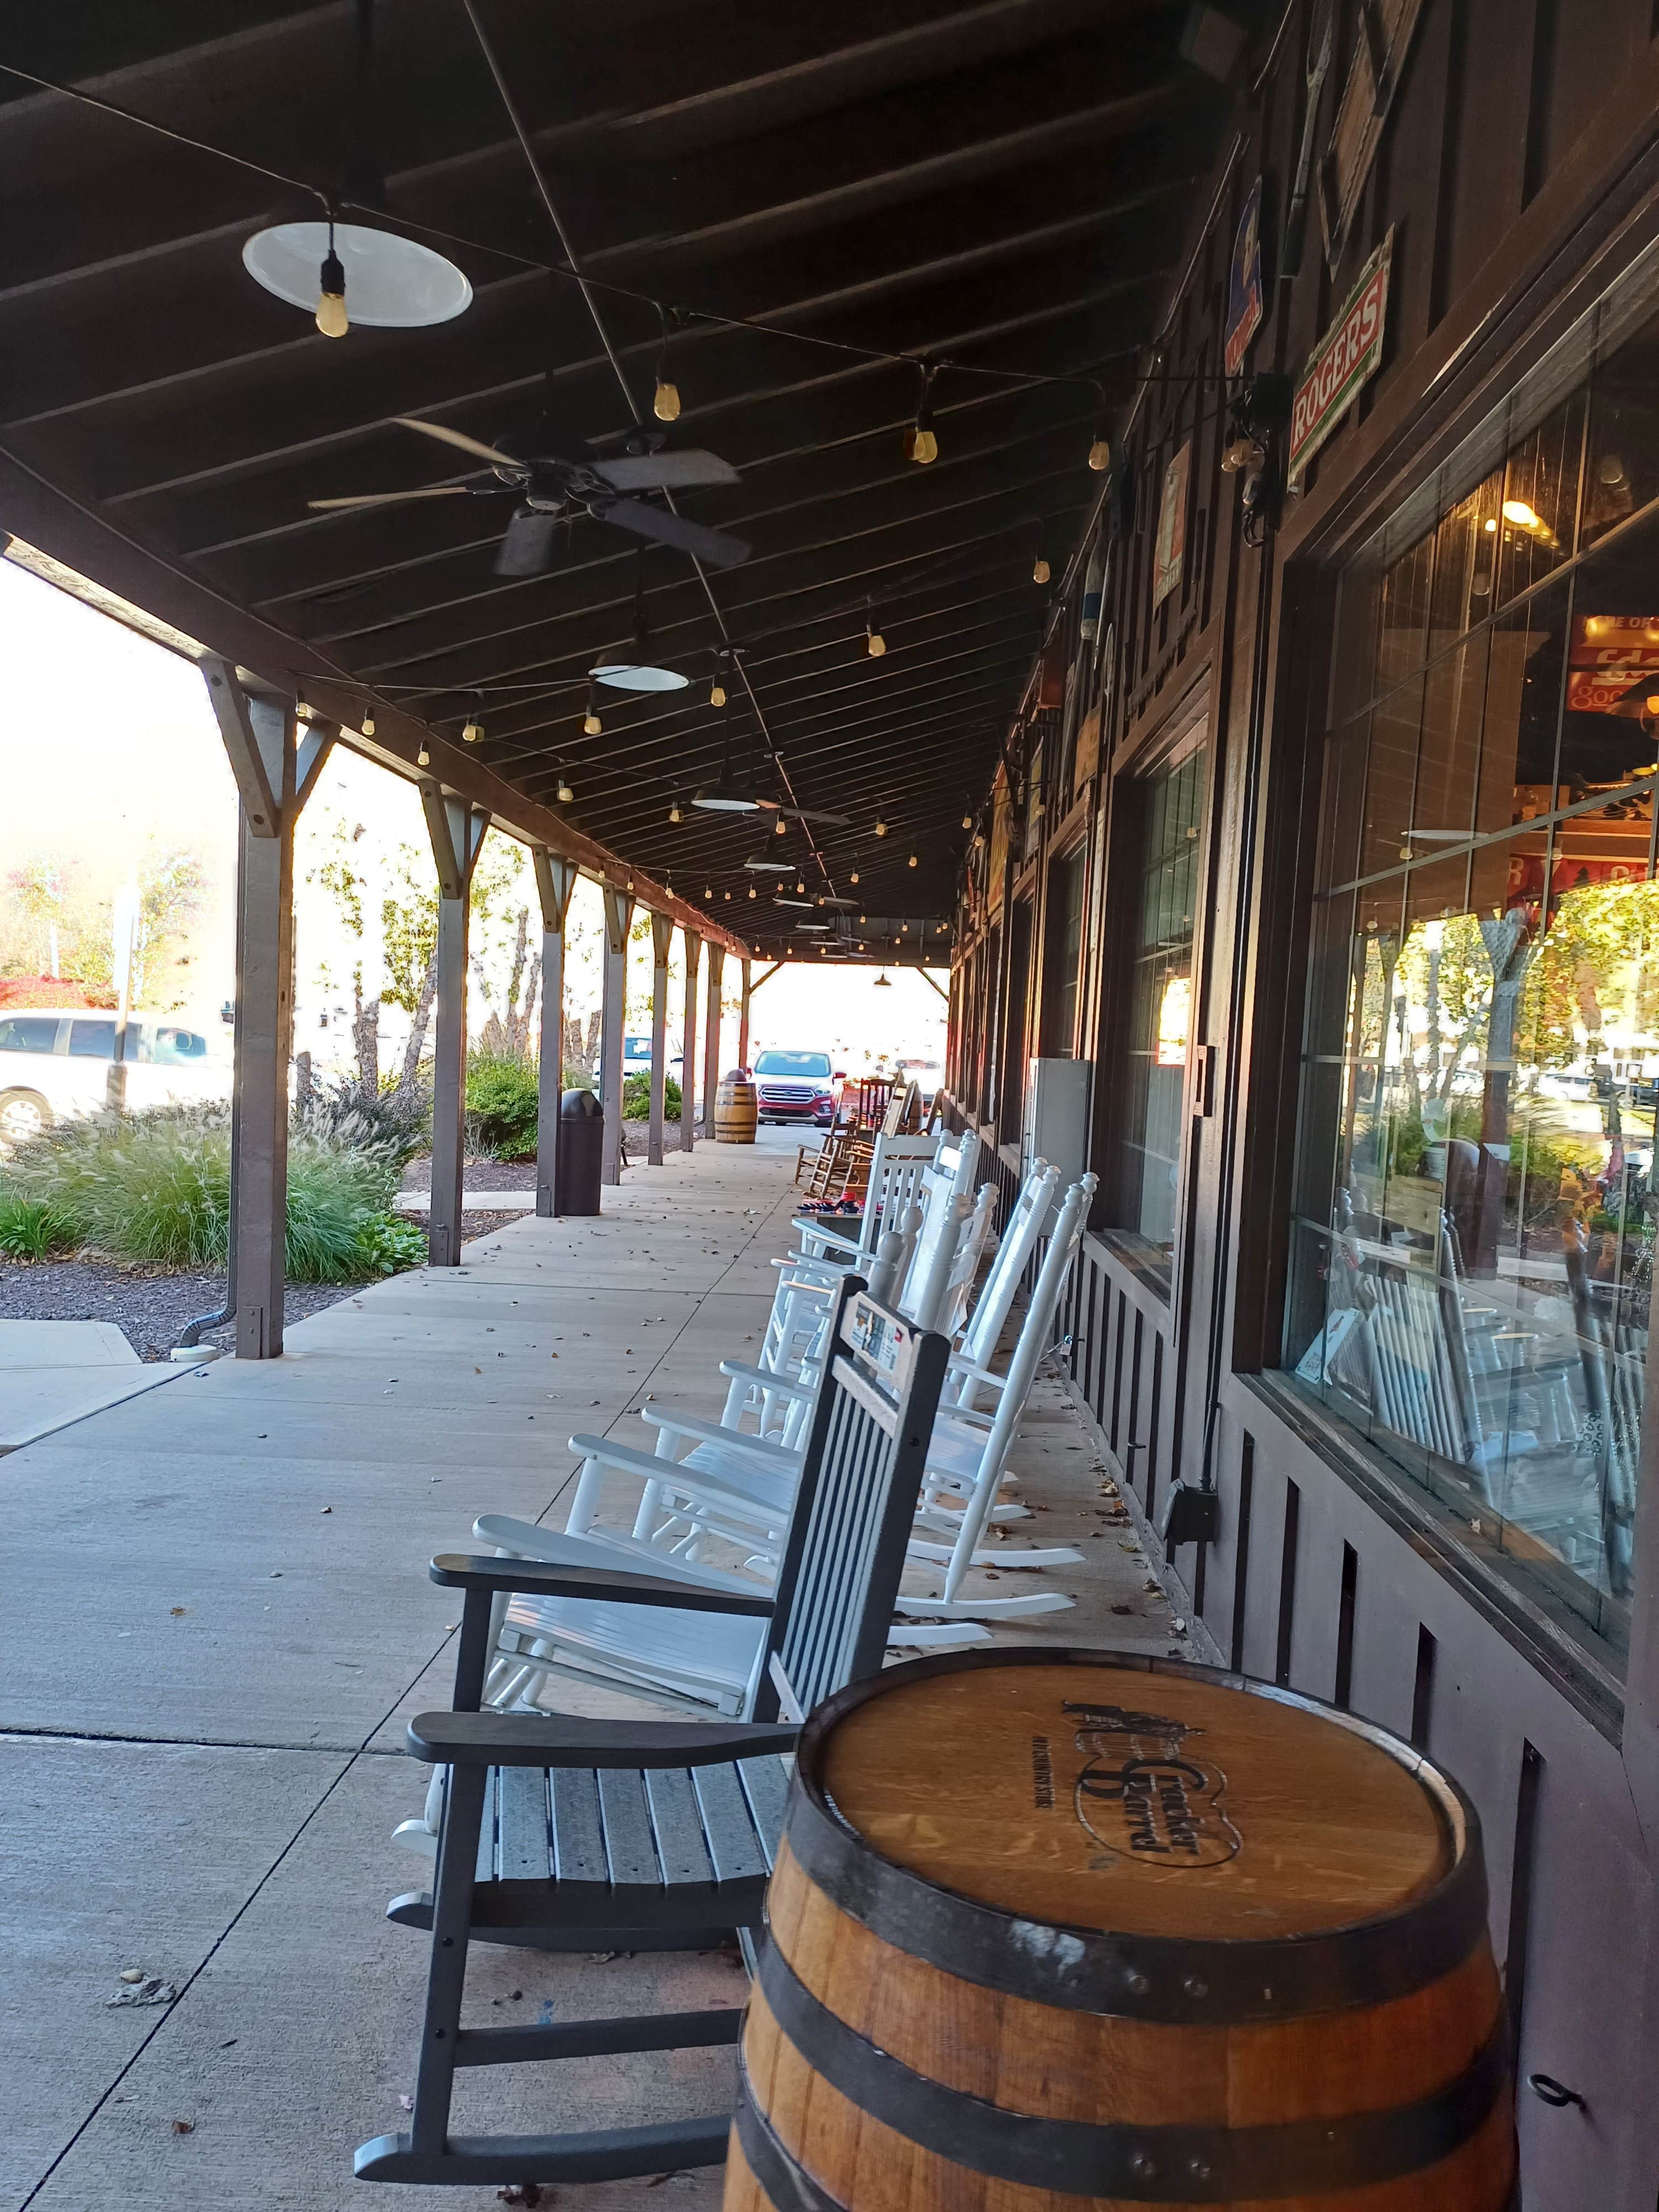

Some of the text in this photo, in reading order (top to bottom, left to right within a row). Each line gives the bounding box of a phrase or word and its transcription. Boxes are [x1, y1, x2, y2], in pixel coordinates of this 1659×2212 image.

[1292, 280, 1379, 450] ROGERS
[1032, 1750, 1052, 1786] COUNTRY
[1078, 1771, 1173, 1854] Barrel
[1124, 1760, 1208, 1856] Cracker
